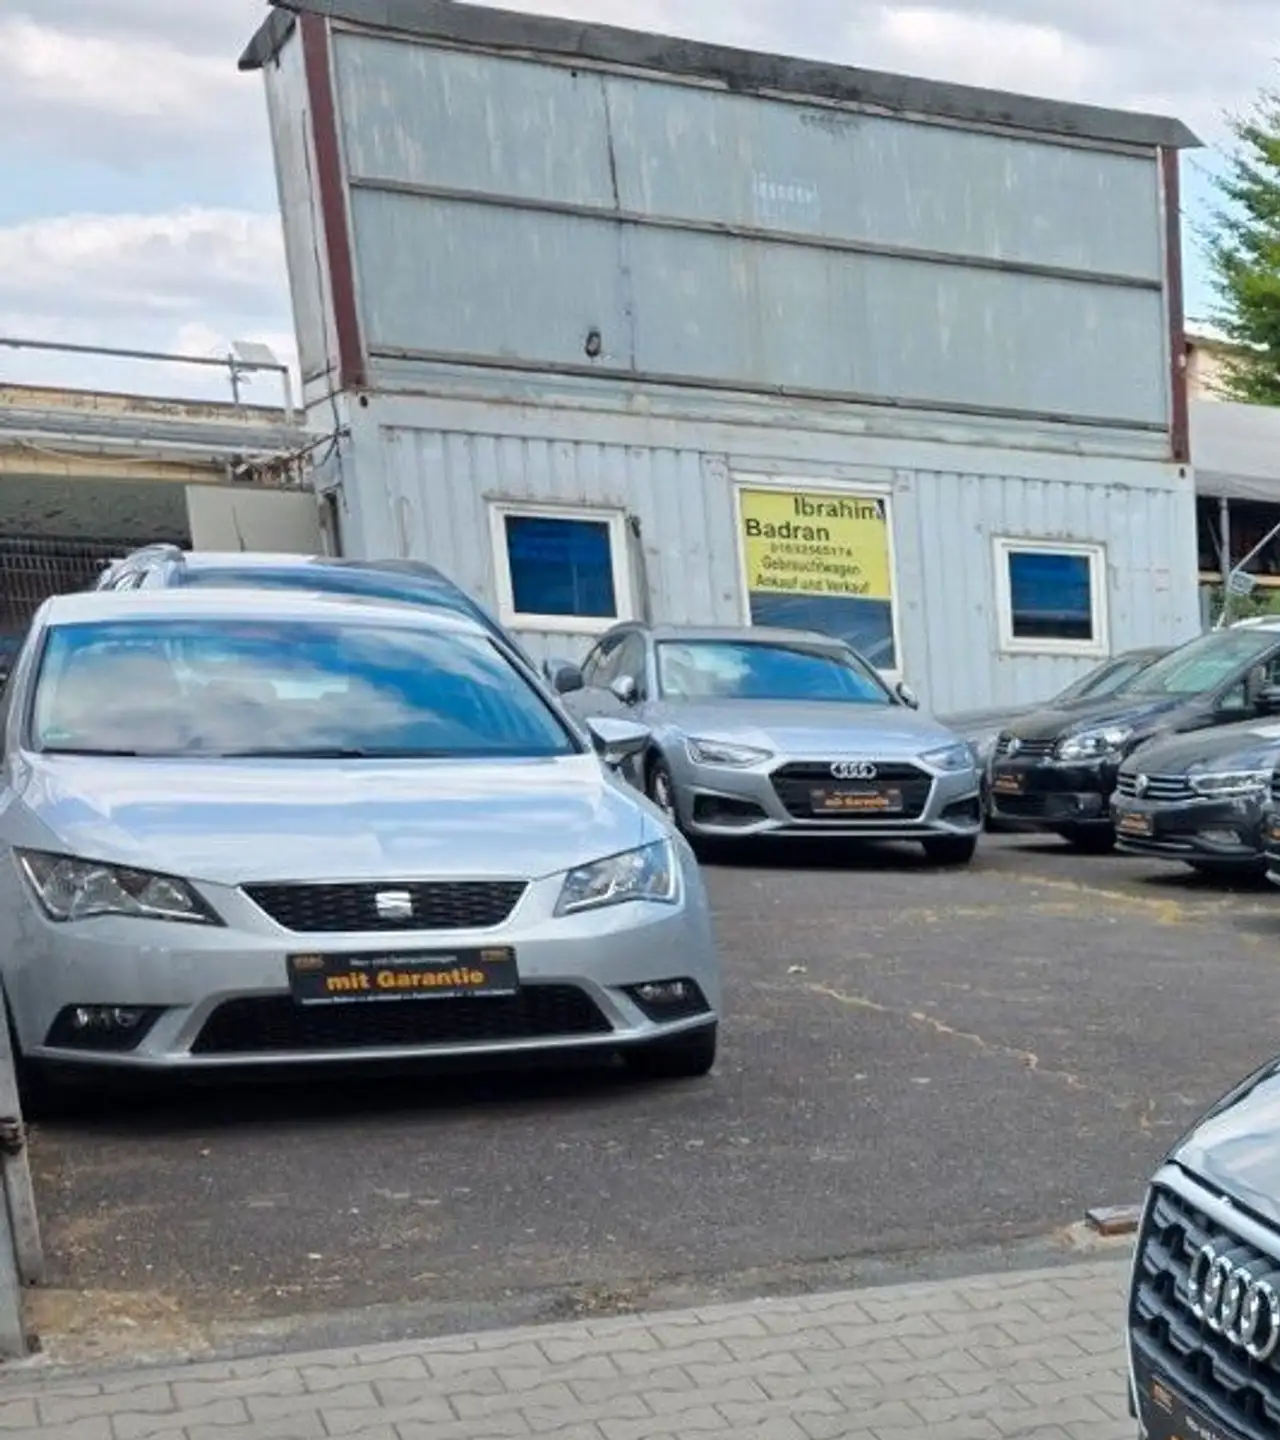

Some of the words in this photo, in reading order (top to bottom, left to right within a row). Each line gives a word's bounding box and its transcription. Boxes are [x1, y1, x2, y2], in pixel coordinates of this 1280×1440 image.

[793, 496, 887, 521] Ibrahim
[744, 517, 831, 542] Badran
[325, 971, 371, 991] mit
[375, 966, 485, 990] Garantie
